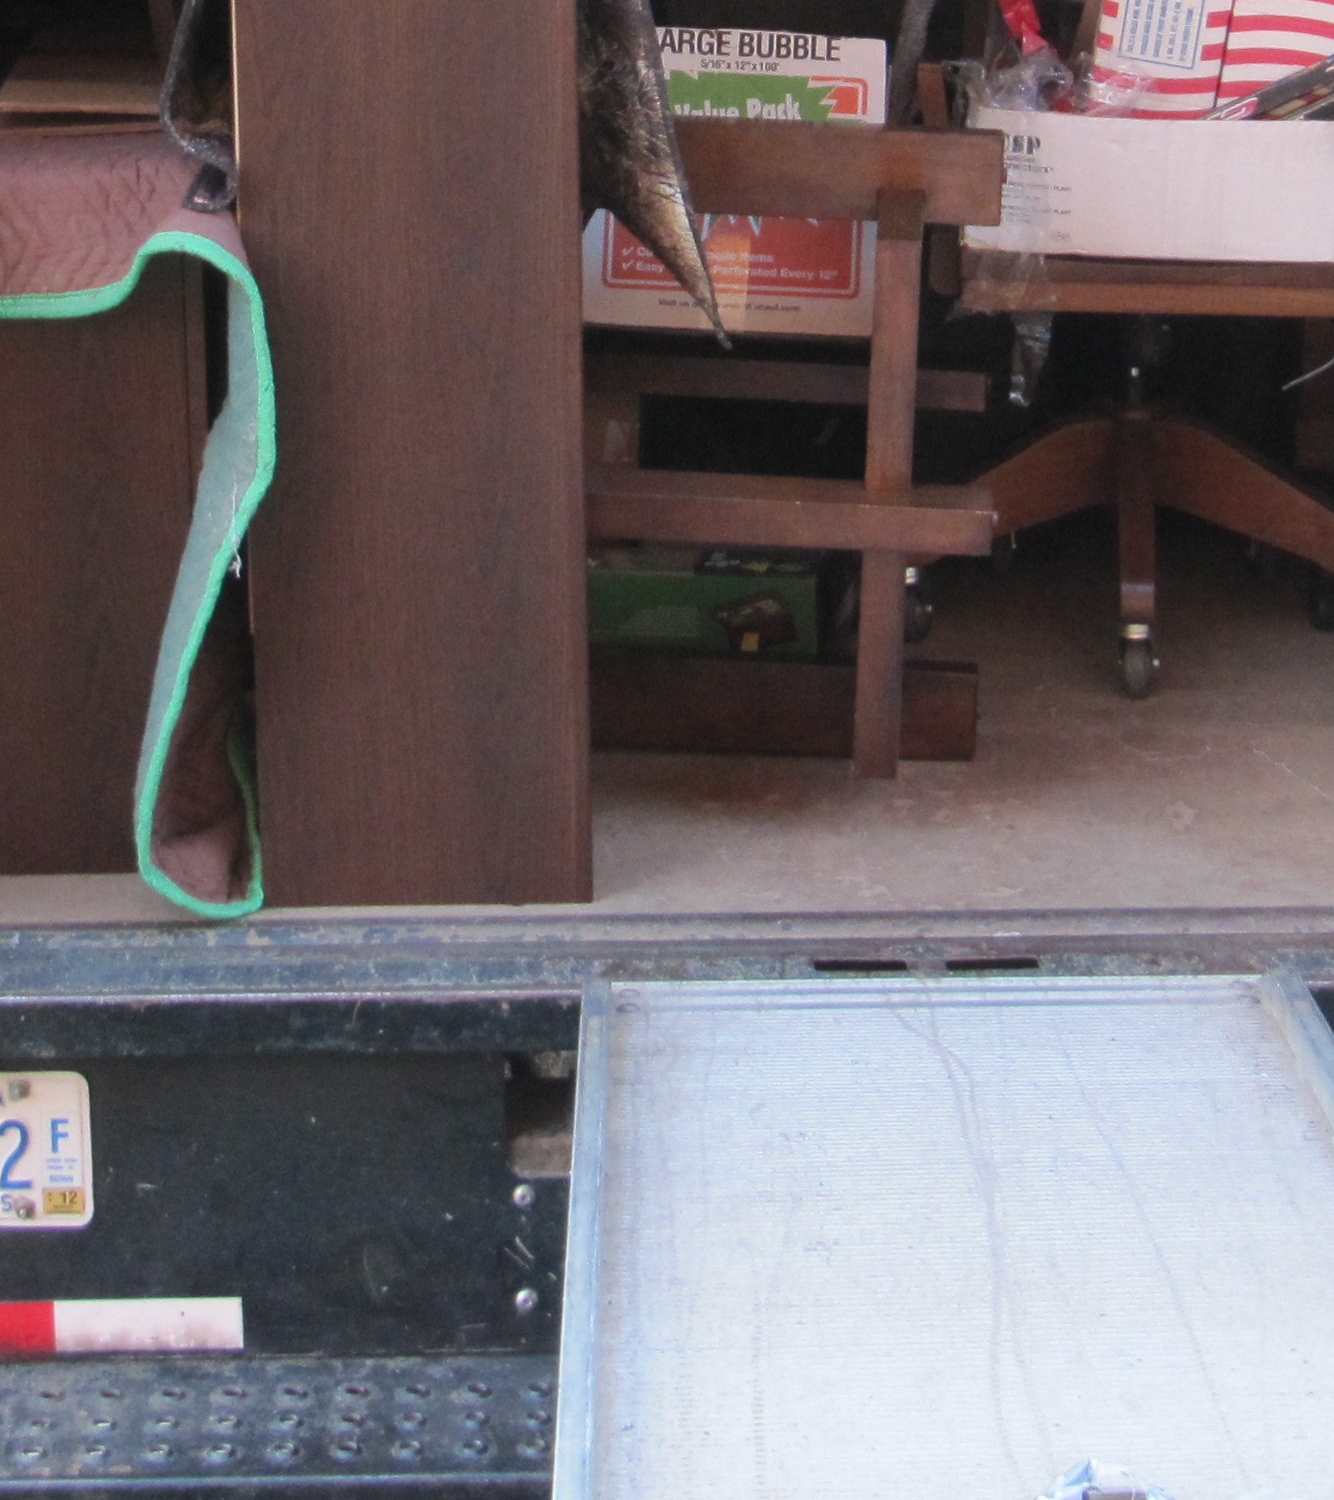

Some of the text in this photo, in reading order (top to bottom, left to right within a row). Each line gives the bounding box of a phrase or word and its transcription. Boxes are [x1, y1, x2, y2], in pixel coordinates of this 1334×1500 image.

[660, 28, 842, 63] ARGE BUBBLE
[747, 93, 802, 120] Pack
[50, 1118, 69, 1153] F
